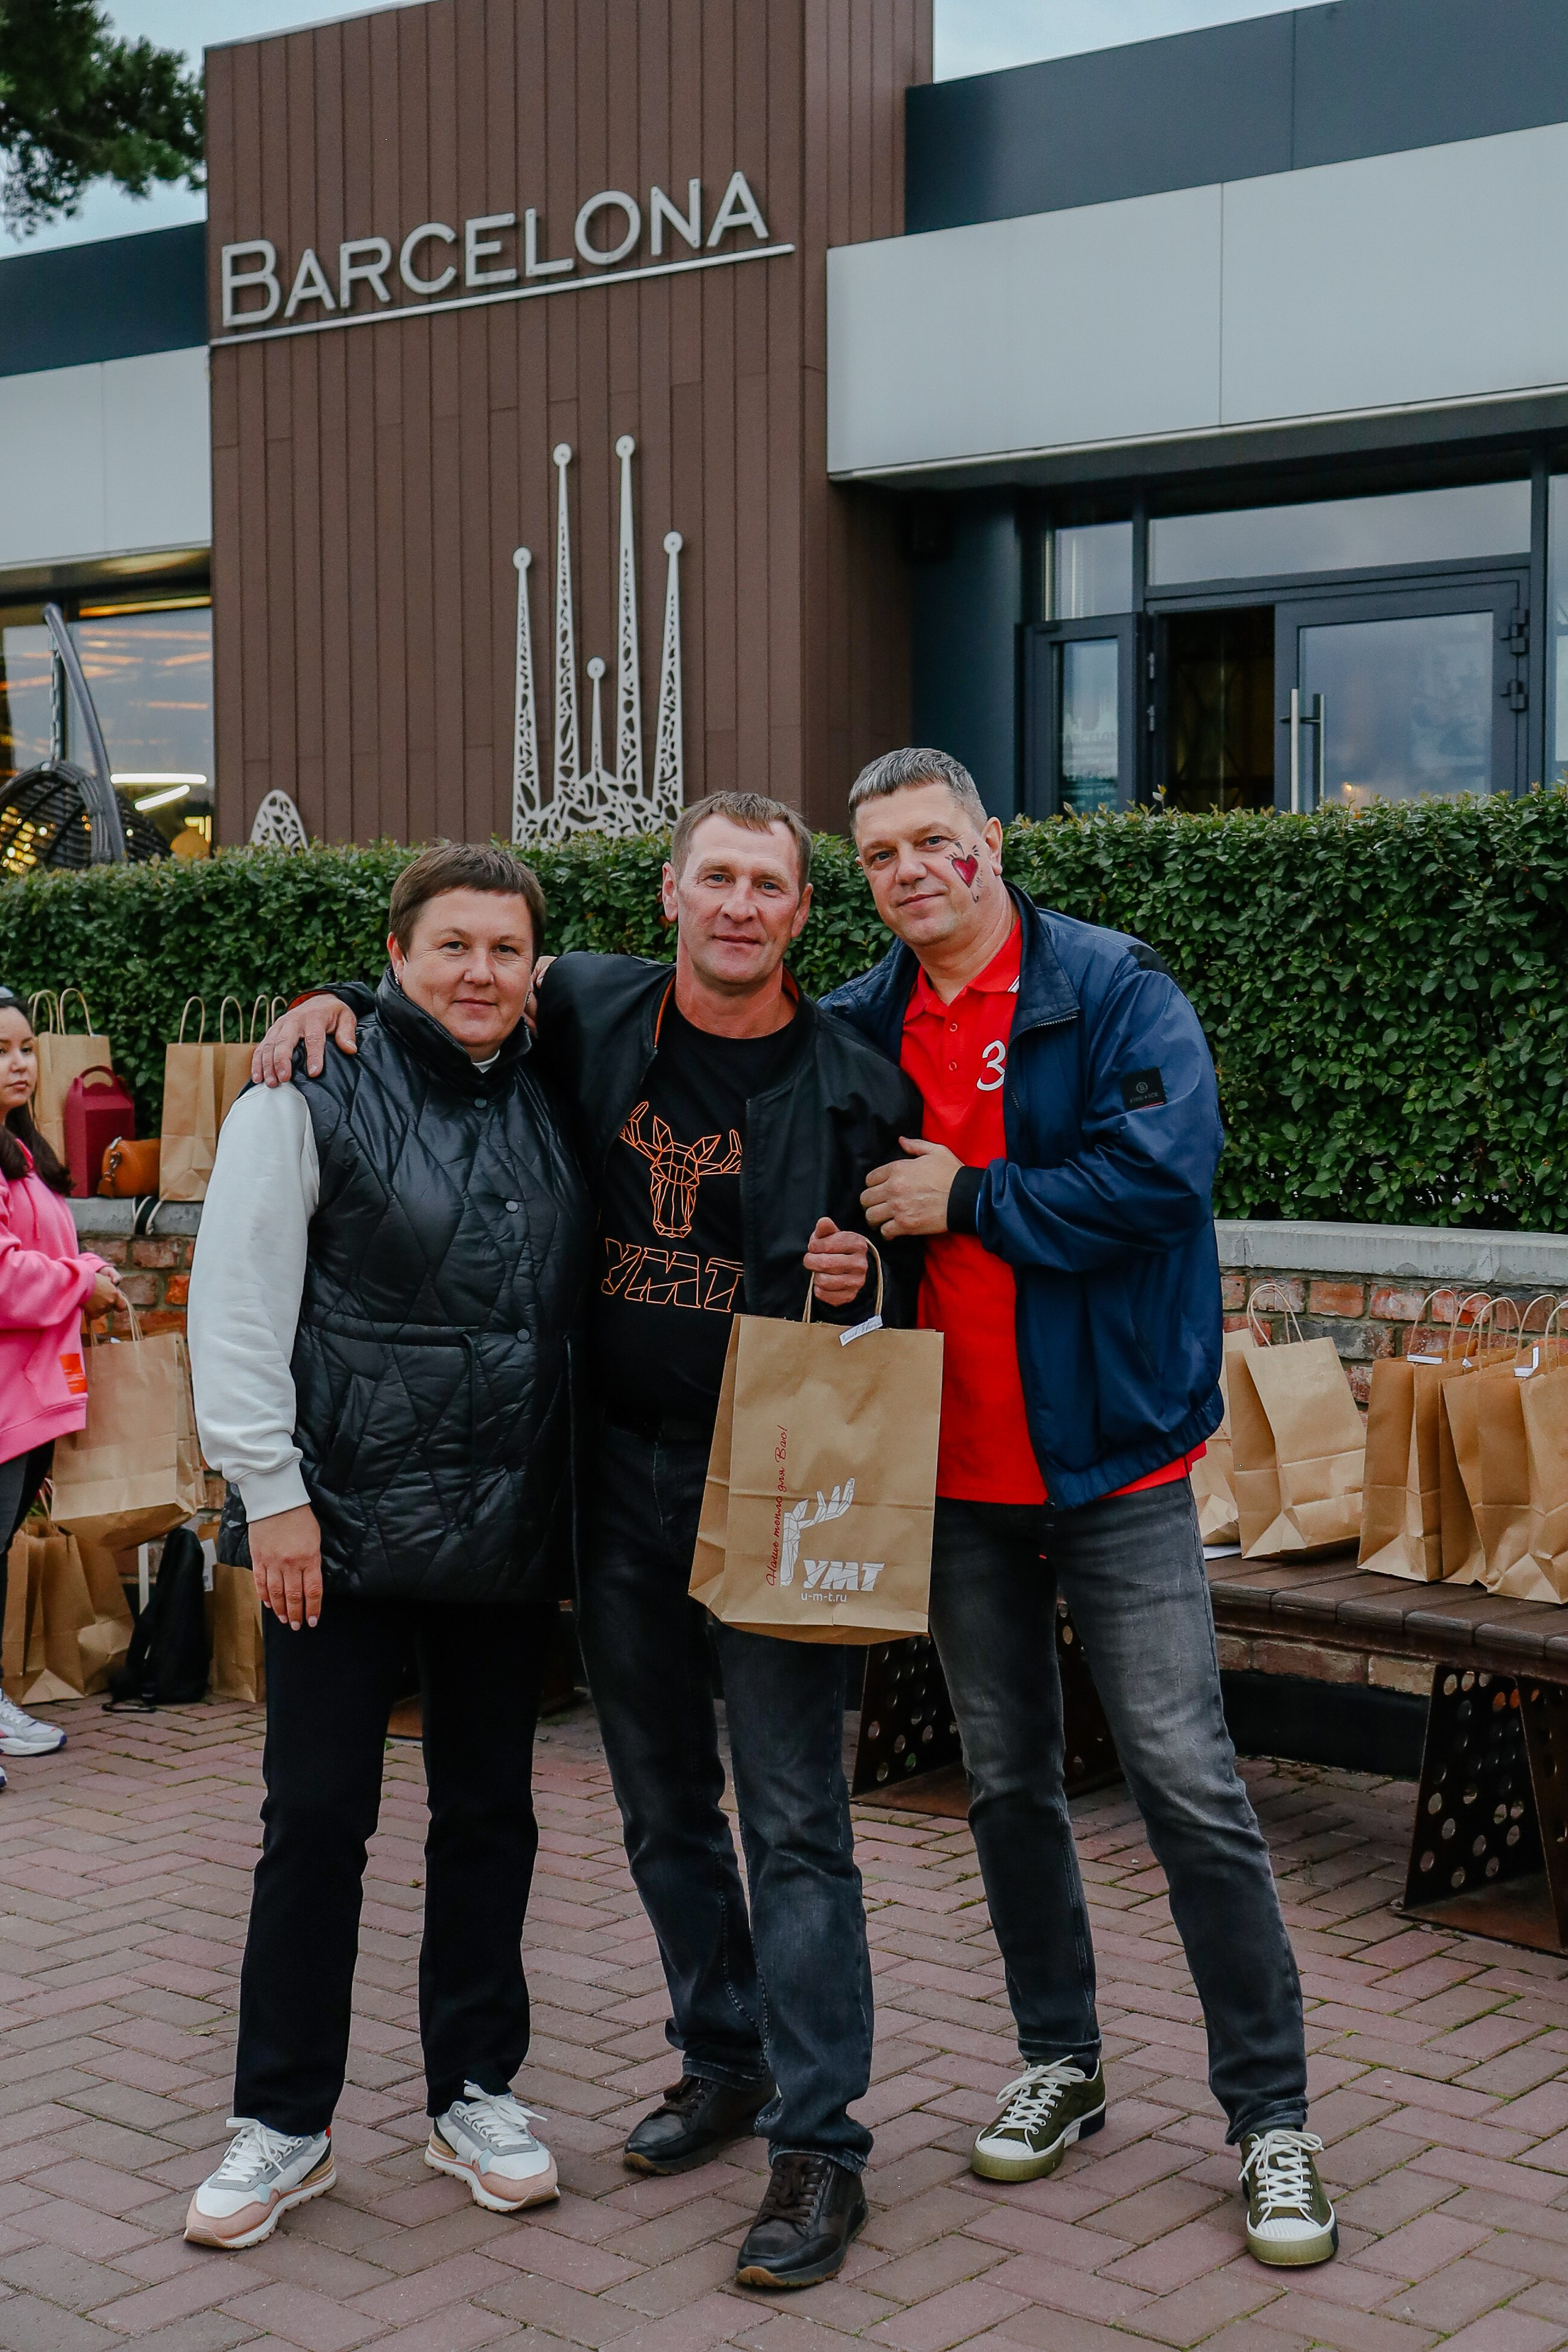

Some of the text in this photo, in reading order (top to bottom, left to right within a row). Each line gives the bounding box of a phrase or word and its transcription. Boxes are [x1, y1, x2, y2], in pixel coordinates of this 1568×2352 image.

[221, 170, 769, 328] BARCELONA
[976, 1039, 1006, 1091] 3
[766, 1425, 788, 1587] Наше тепло для Вас!
[801, 1592, 847, 1603] u-m-t.ru
[802, 1559, 886, 1592] УМТ
